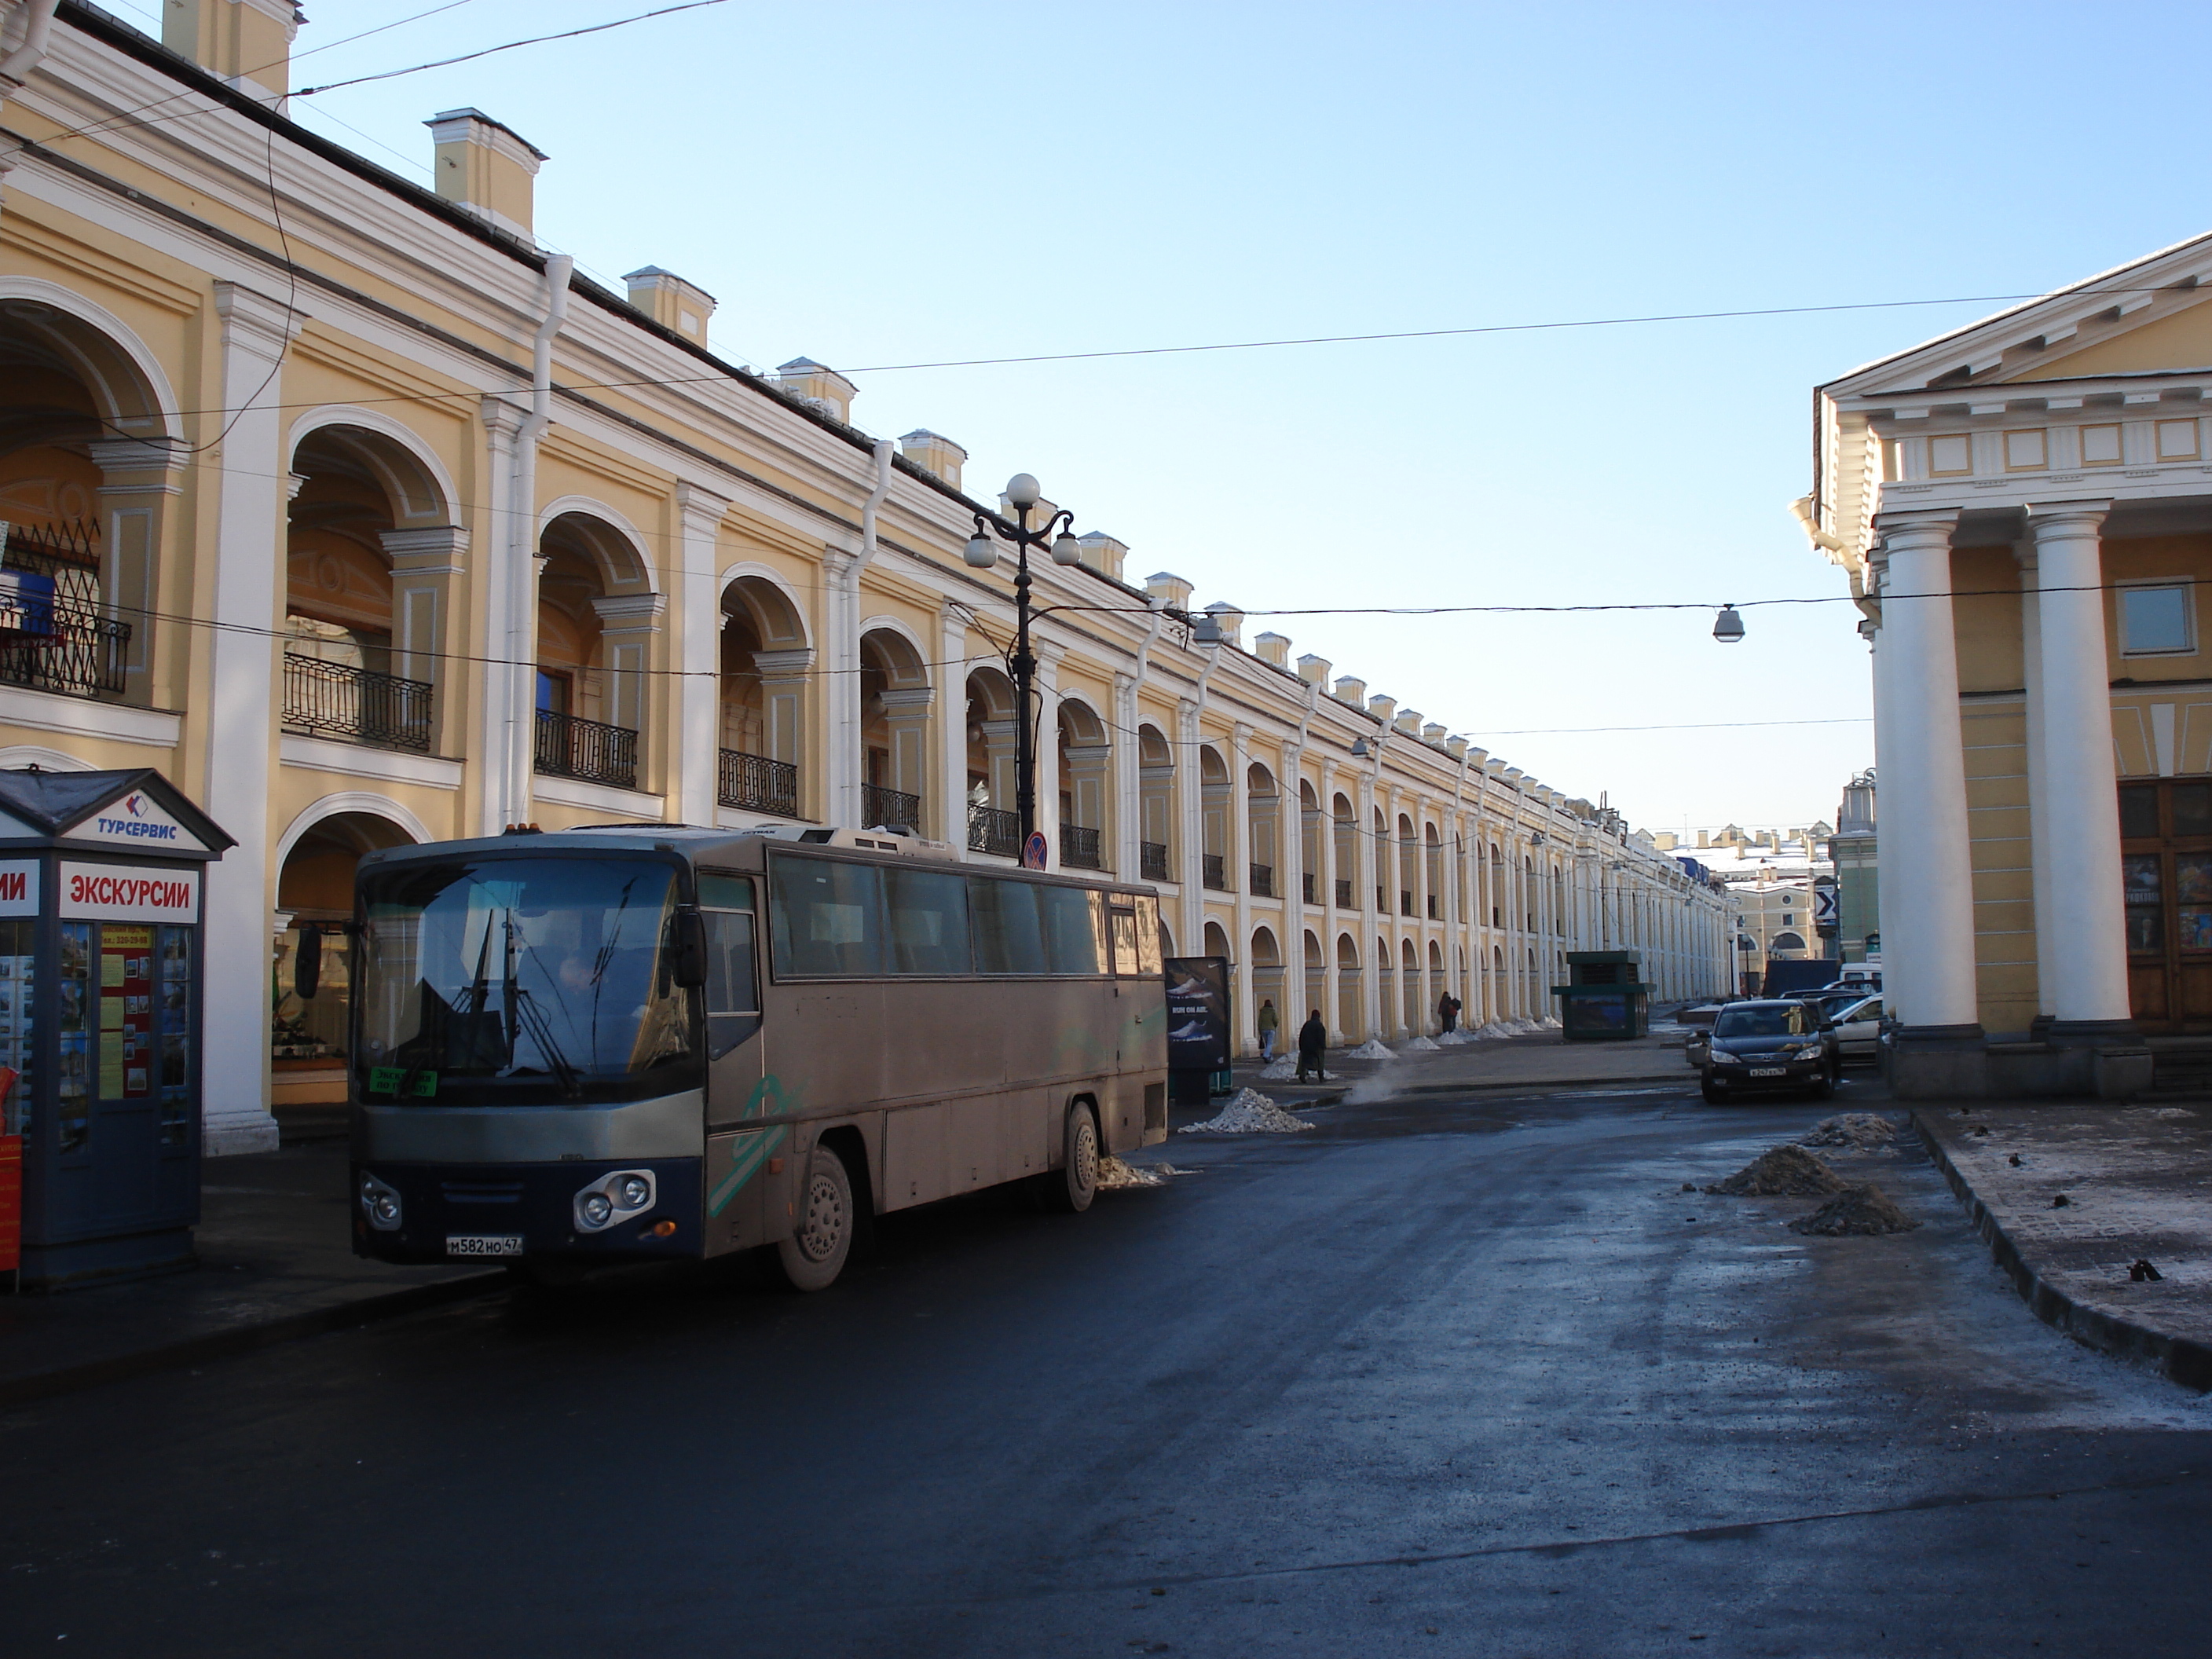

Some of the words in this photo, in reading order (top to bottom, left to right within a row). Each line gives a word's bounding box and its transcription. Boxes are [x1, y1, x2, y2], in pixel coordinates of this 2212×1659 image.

[98, 818, 177, 840] ТУРСЕРВИС
[70, 874, 189, 908] ЭКСКУРСИИ
[375, 1068, 431, 1082] Экския
[450, 1239, 502, 1253] М582НО
[504, 1239, 518, 1250] 47
